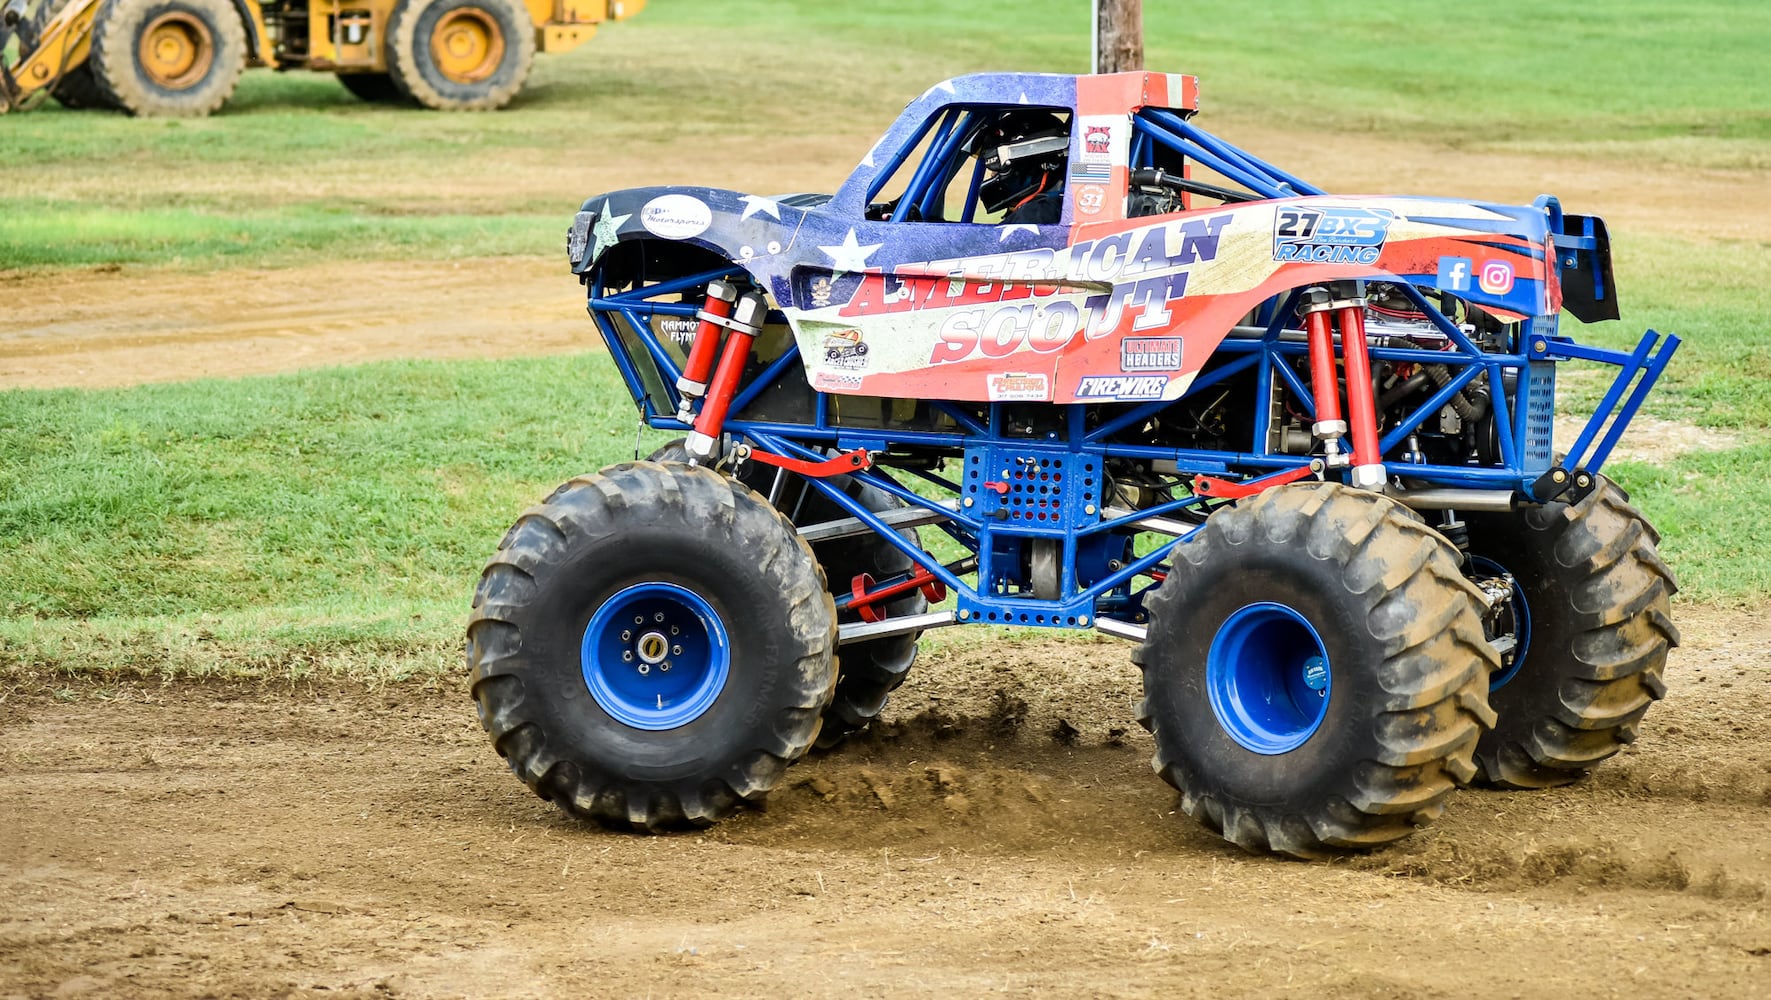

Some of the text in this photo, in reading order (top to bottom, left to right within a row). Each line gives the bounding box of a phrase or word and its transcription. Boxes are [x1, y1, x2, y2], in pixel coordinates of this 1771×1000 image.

[1079, 193, 1104, 207] 31
[1279, 213, 1319, 237] 27
[1277, 244, 1379, 263] RACING
[838, 214, 1233, 317] AMERICAN
[929, 272, 1189, 364] SCOUT
[1126, 341, 1179, 353] ULTIMATE
[1126, 354, 1179, 367] HEADERS
[1076, 377, 1169, 396] FIREWIRE
